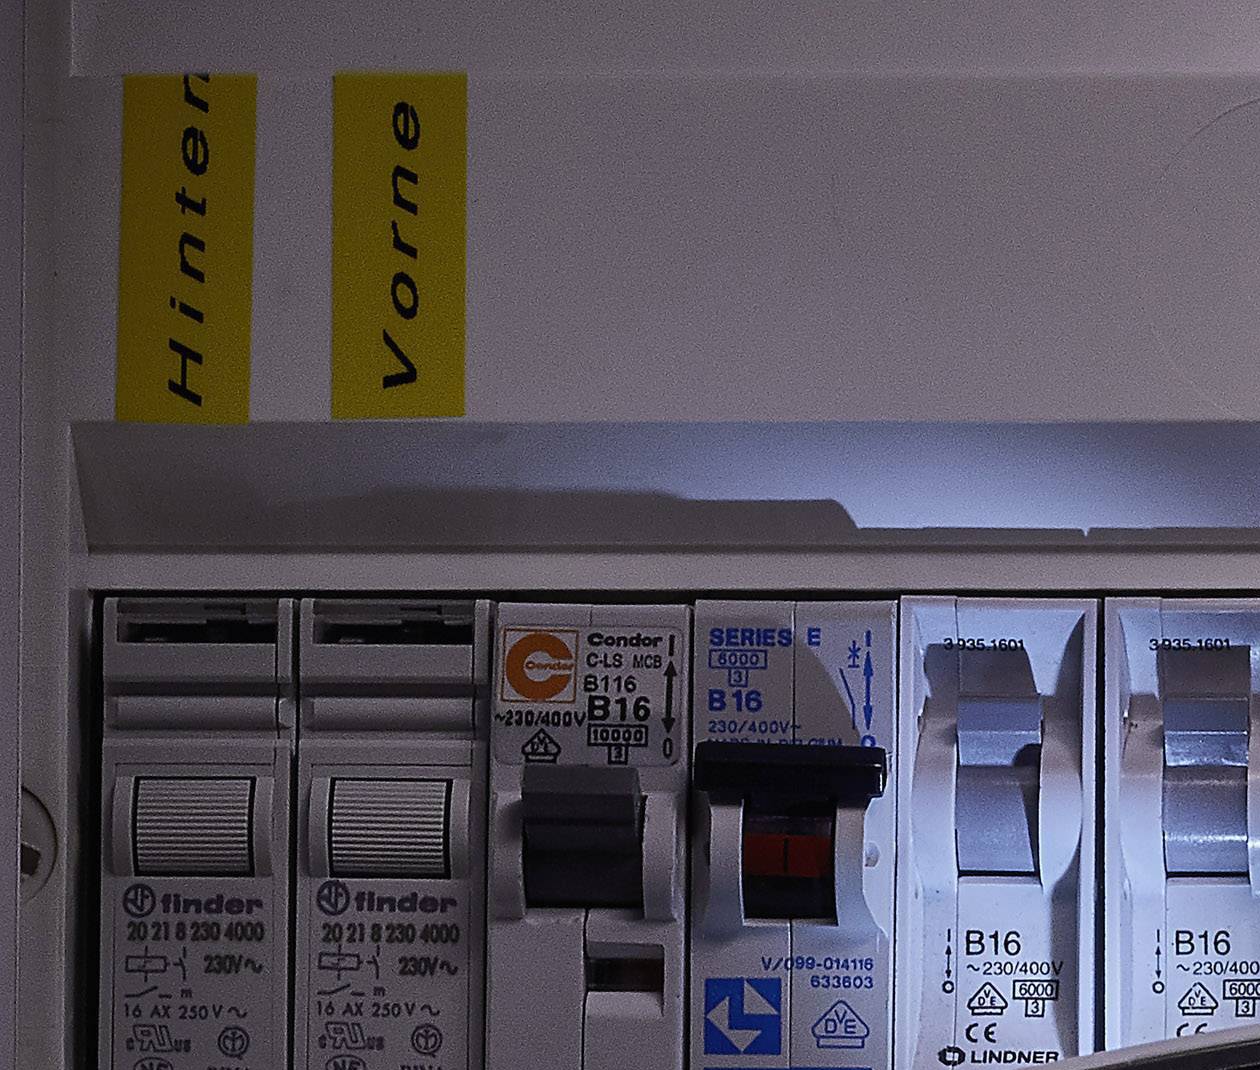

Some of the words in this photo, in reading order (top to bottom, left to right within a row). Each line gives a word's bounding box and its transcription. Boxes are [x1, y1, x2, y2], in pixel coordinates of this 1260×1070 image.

[168, 73, 210, 407] Hinten
[382, 101, 421, 389] Vorne
[587, 632, 663, 648] Condor
[709, 627, 793, 647] SERIES
[807, 627, 822, 647] E
[586, 652, 623, 668] C-LS
[632, 653, 662, 669] MCB
[718, 652, 760, 665] 6000
[583, 674, 637, 693] B116
[733, 671, 743, 683] 3
[587, 695, 651, 722] B16
[592, 728, 643, 742] 10000
[161, 893, 263, 914] finder
[354, 890, 458, 913] finder
[127, 921, 148, 941] 20
[151, 922, 170, 941] 21
[175, 922, 186, 941] 8
[190, 922, 220, 941] 230
[224, 922, 264, 941] 4000
[322, 922, 343, 943] 20
[346, 923, 365, 943] 21
[371, 923, 382, 943] 8
[385, 923, 416, 943] 230
[420, 923, 460, 943] 4000
[965, 930, 1022, 956] B16
[1175, 930, 1231, 956] B16
[1019, 983, 1054, 996] 6000
[123, 1003, 142, 1018] 16
[150, 1004, 171, 1018] AX
[317, 1001, 335, 1016] 16
[342, 1002, 364, 1016] AX
[1031, 1001, 1040, 1014] 3
[1241, 1001, 1250, 1014] 3
[965, 1022, 997, 1043] CE
[970, 1051, 1059, 1064] LINDNER
